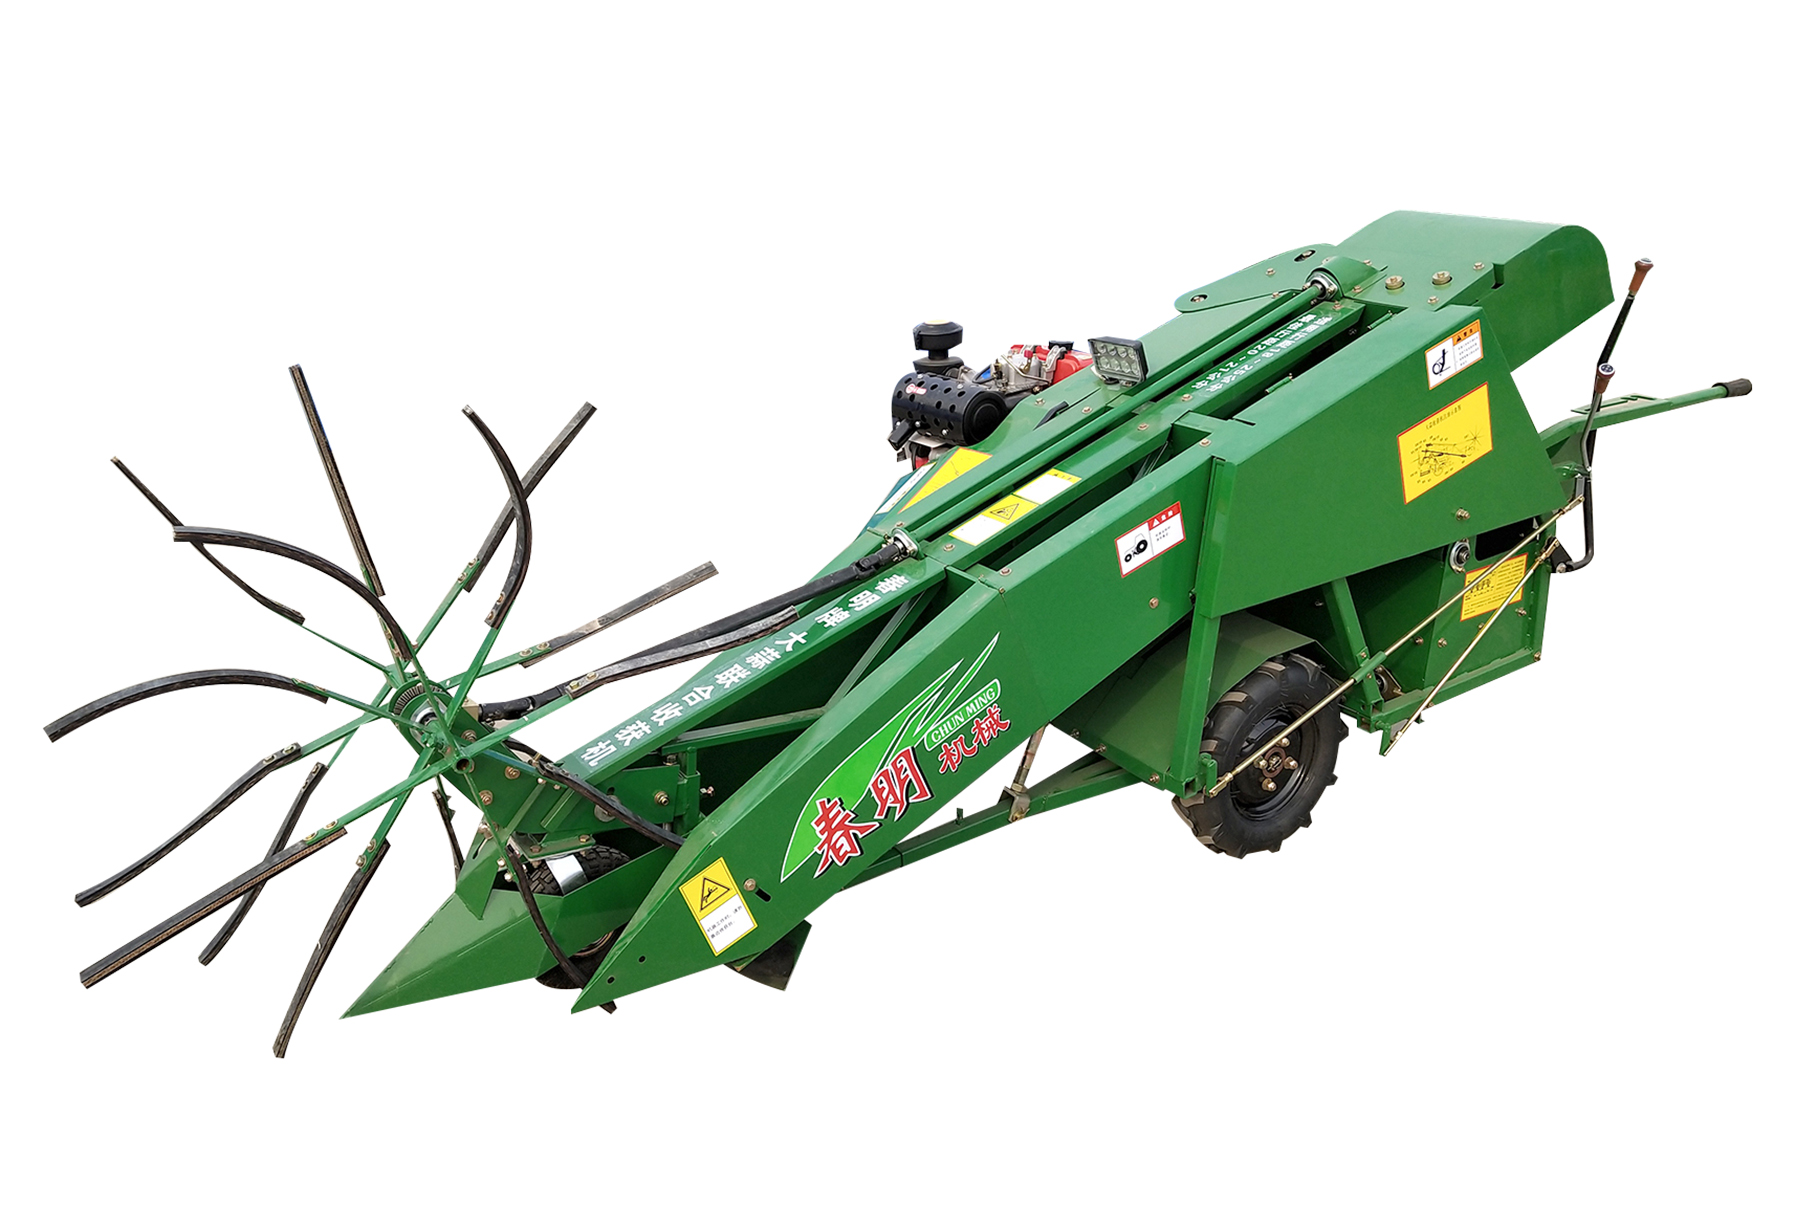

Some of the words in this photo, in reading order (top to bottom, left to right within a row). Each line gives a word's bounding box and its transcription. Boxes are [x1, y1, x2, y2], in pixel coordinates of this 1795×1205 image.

[815, 574, 909, 628] 春明牌
[580, 630, 809, 767] 大蒜联合收获机
[931, 710, 965, 744] CHUN
[964, 687, 996, 717] MING
[811, 746, 934, 880] 春明
[938, 704, 1011, 775] 机械
